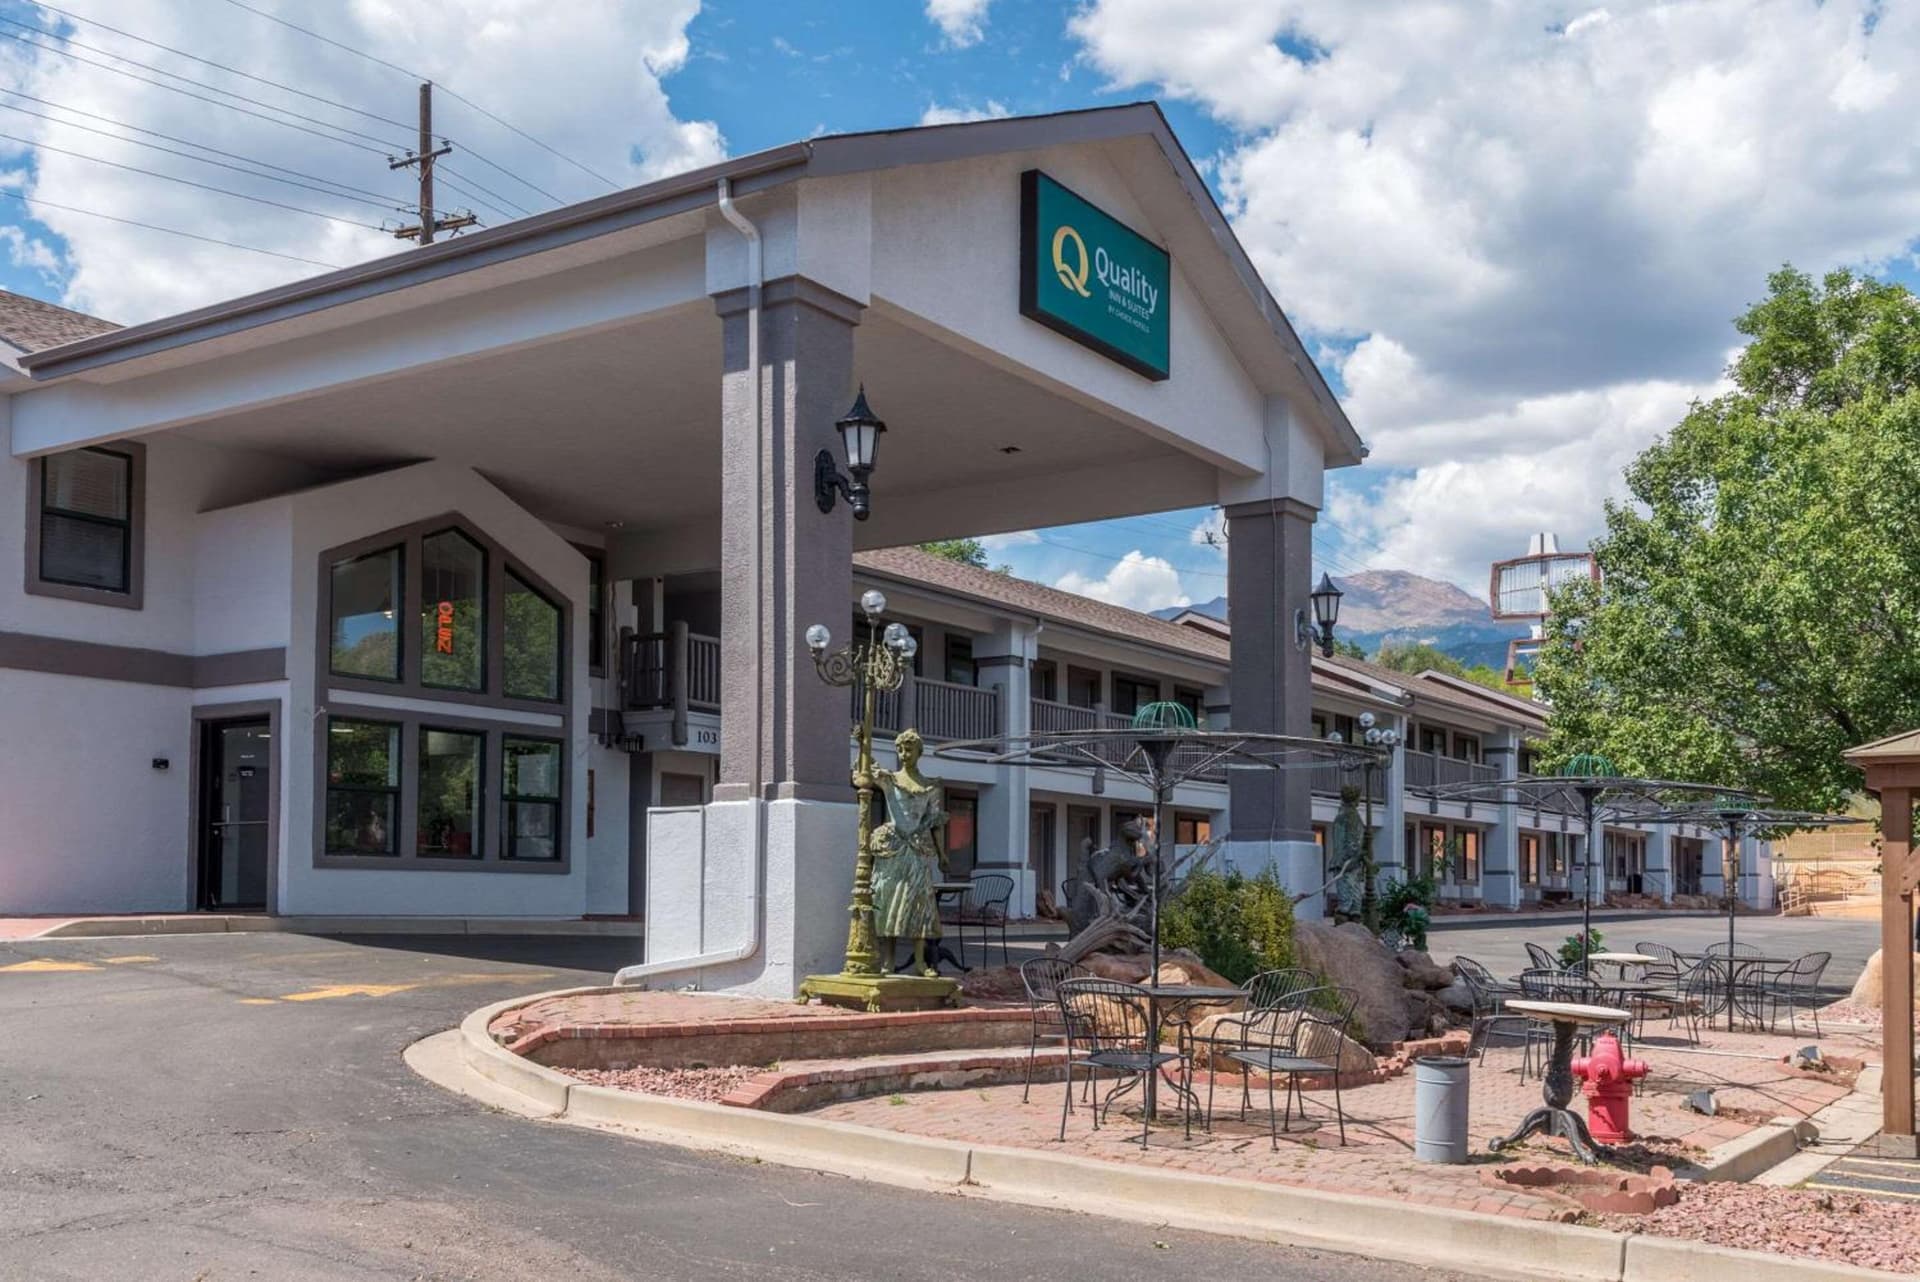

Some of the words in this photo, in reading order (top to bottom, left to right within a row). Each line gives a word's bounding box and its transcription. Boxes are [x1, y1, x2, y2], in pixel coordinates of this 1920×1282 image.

[1053, 226, 1091, 297] Q
[1095, 247, 1157, 313] Quality
[1127, 299, 1150, 320] SUITES
[438, 601, 453, 653] OPEN
[697, 730, 717, 744] 103
